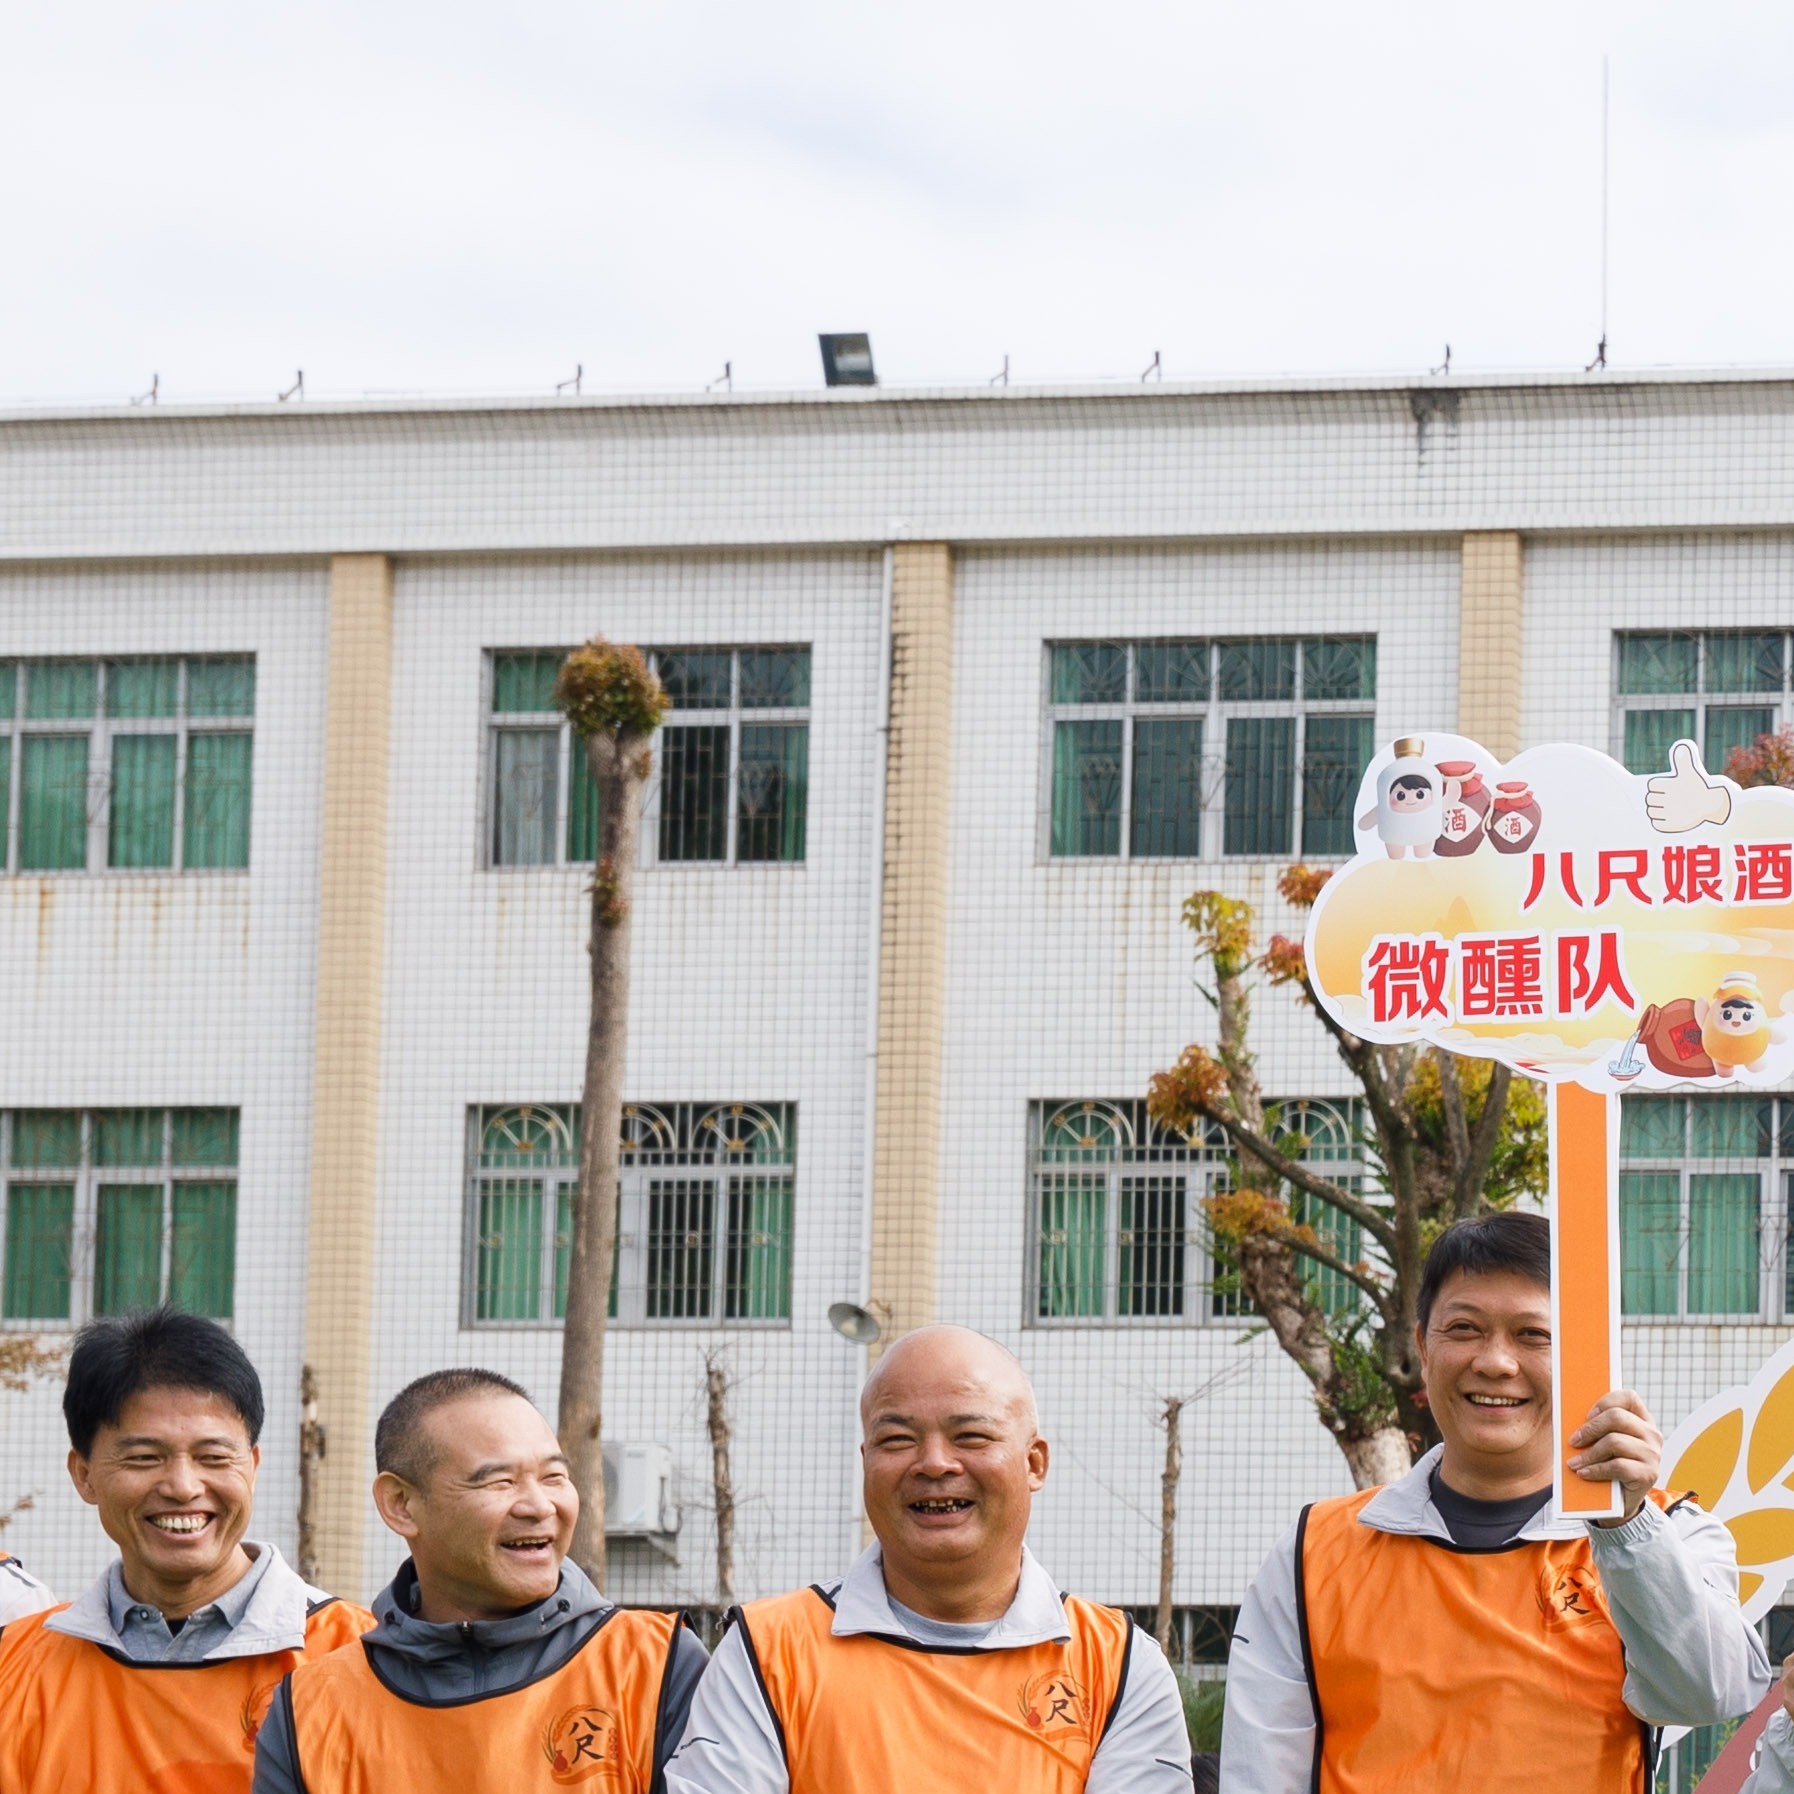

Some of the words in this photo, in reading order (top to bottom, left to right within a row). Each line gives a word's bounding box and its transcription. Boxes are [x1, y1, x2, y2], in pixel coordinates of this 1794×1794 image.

[1444, 808, 1468, 833] 酒
[1505, 816, 1522, 837] 酒
[1523, 842, 1793, 911] 八尺娘酒
[1368, 931, 1635, 1023] 微醺队
[1557, 1576, 1591, 1615] 八尺
[1044, 1680, 1077, 1724] 八尺
[568, 1716, 605, 1765] 八尺
